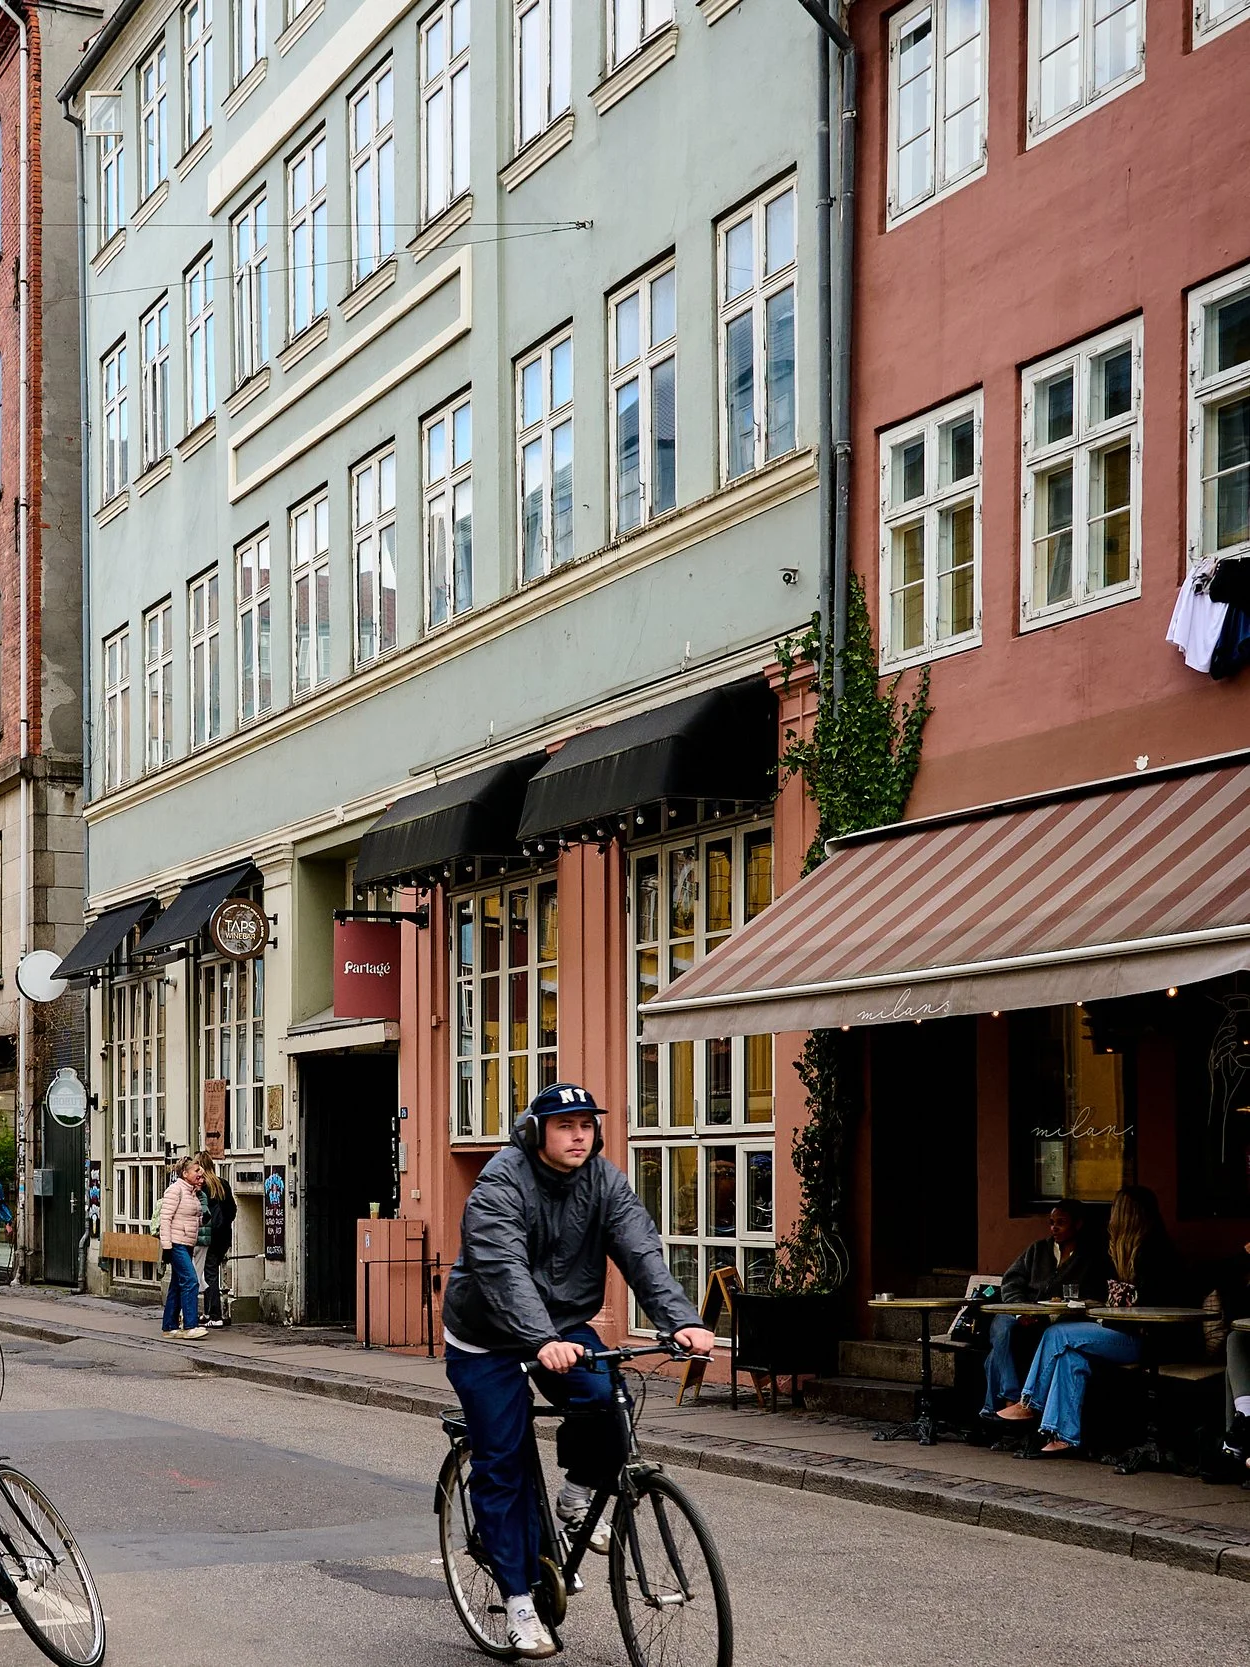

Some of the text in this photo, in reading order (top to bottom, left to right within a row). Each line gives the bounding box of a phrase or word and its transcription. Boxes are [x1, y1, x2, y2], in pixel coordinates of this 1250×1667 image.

[225, 920, 256, 933] TAPS
[343, 961, 391, 977] Partagé
[558, 1088, 587, 1104] NY
